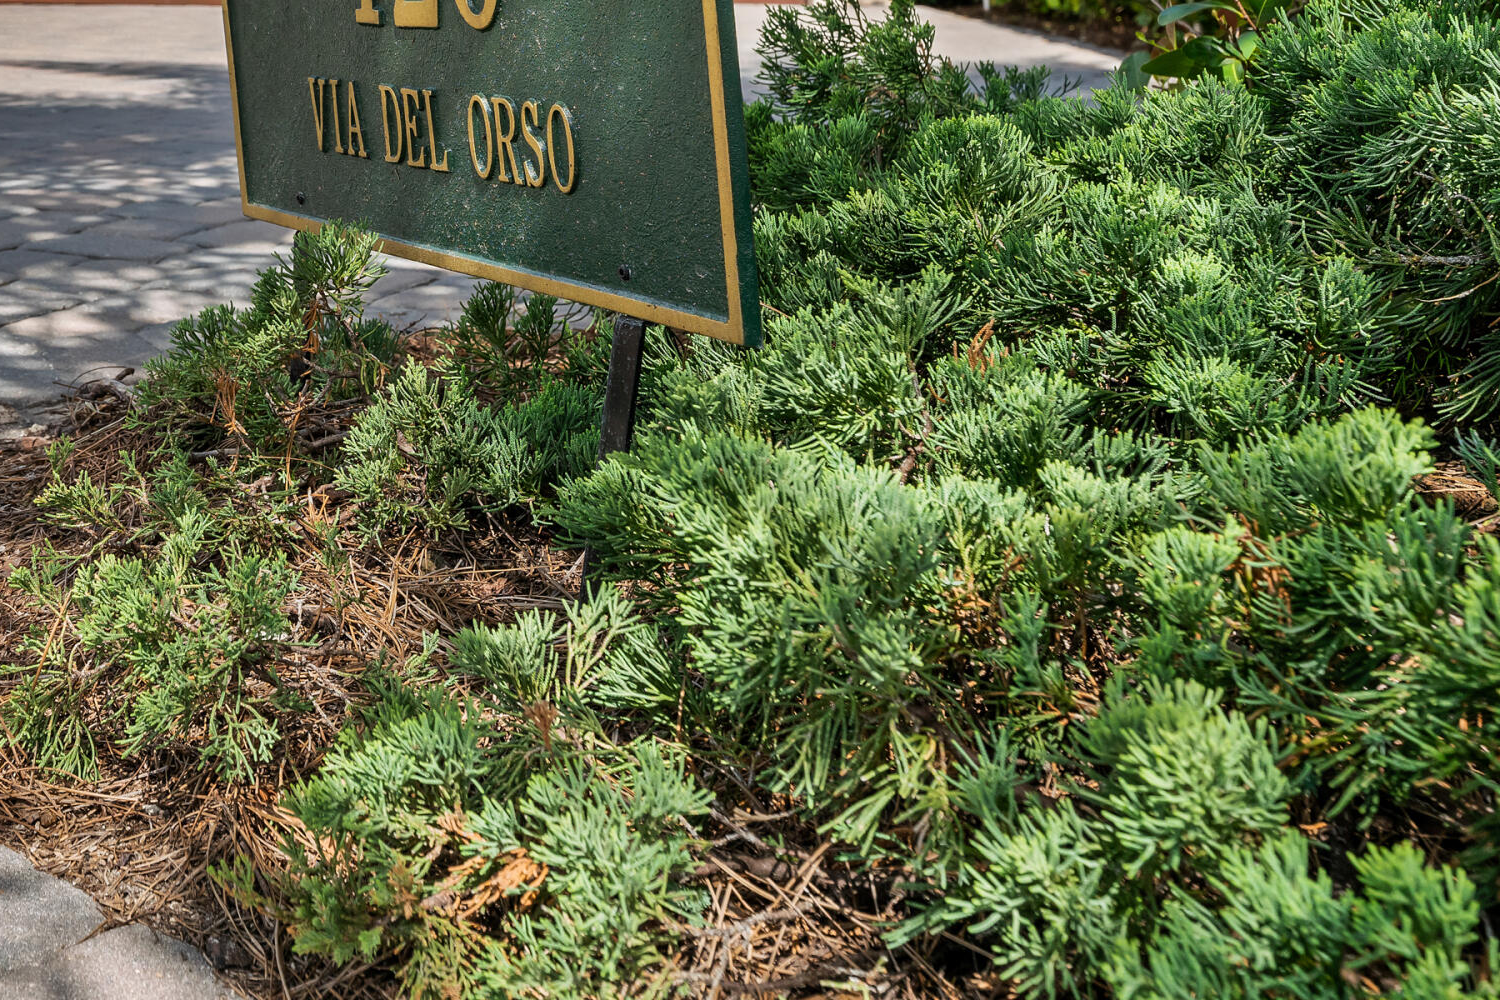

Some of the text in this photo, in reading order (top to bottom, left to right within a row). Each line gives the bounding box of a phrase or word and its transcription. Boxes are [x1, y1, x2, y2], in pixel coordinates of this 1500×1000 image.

[308, 77, 576, 194] VIA DEL ORSO
